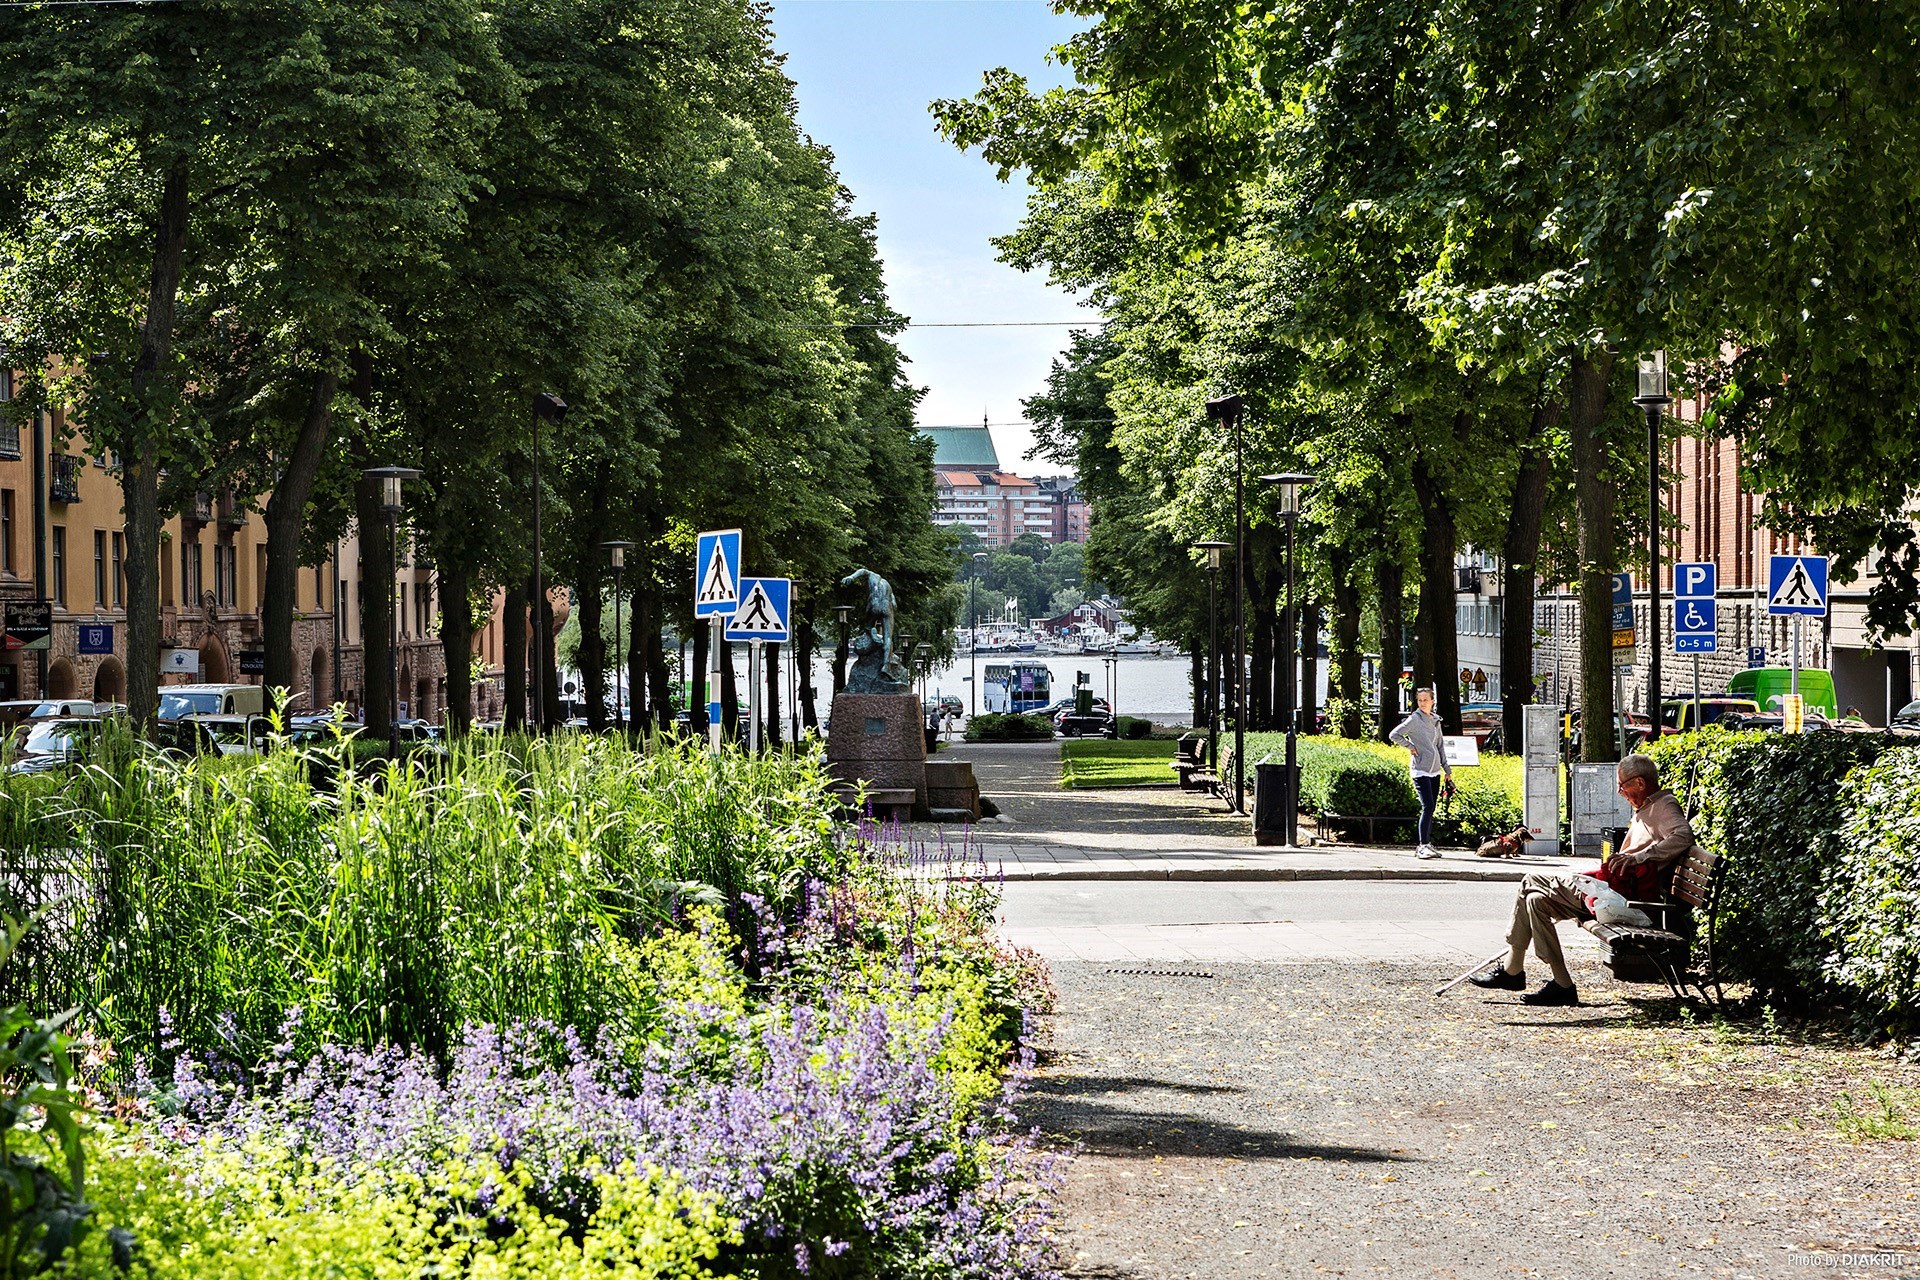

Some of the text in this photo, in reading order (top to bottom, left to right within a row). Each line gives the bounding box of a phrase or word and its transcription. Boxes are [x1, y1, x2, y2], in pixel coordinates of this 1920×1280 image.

[1687, 567, 1706, 594] P
[1704, 640, 1712, 648] m
[1753, 647, 1762, 660] P
[1804, 702, 1826, 714] ing
